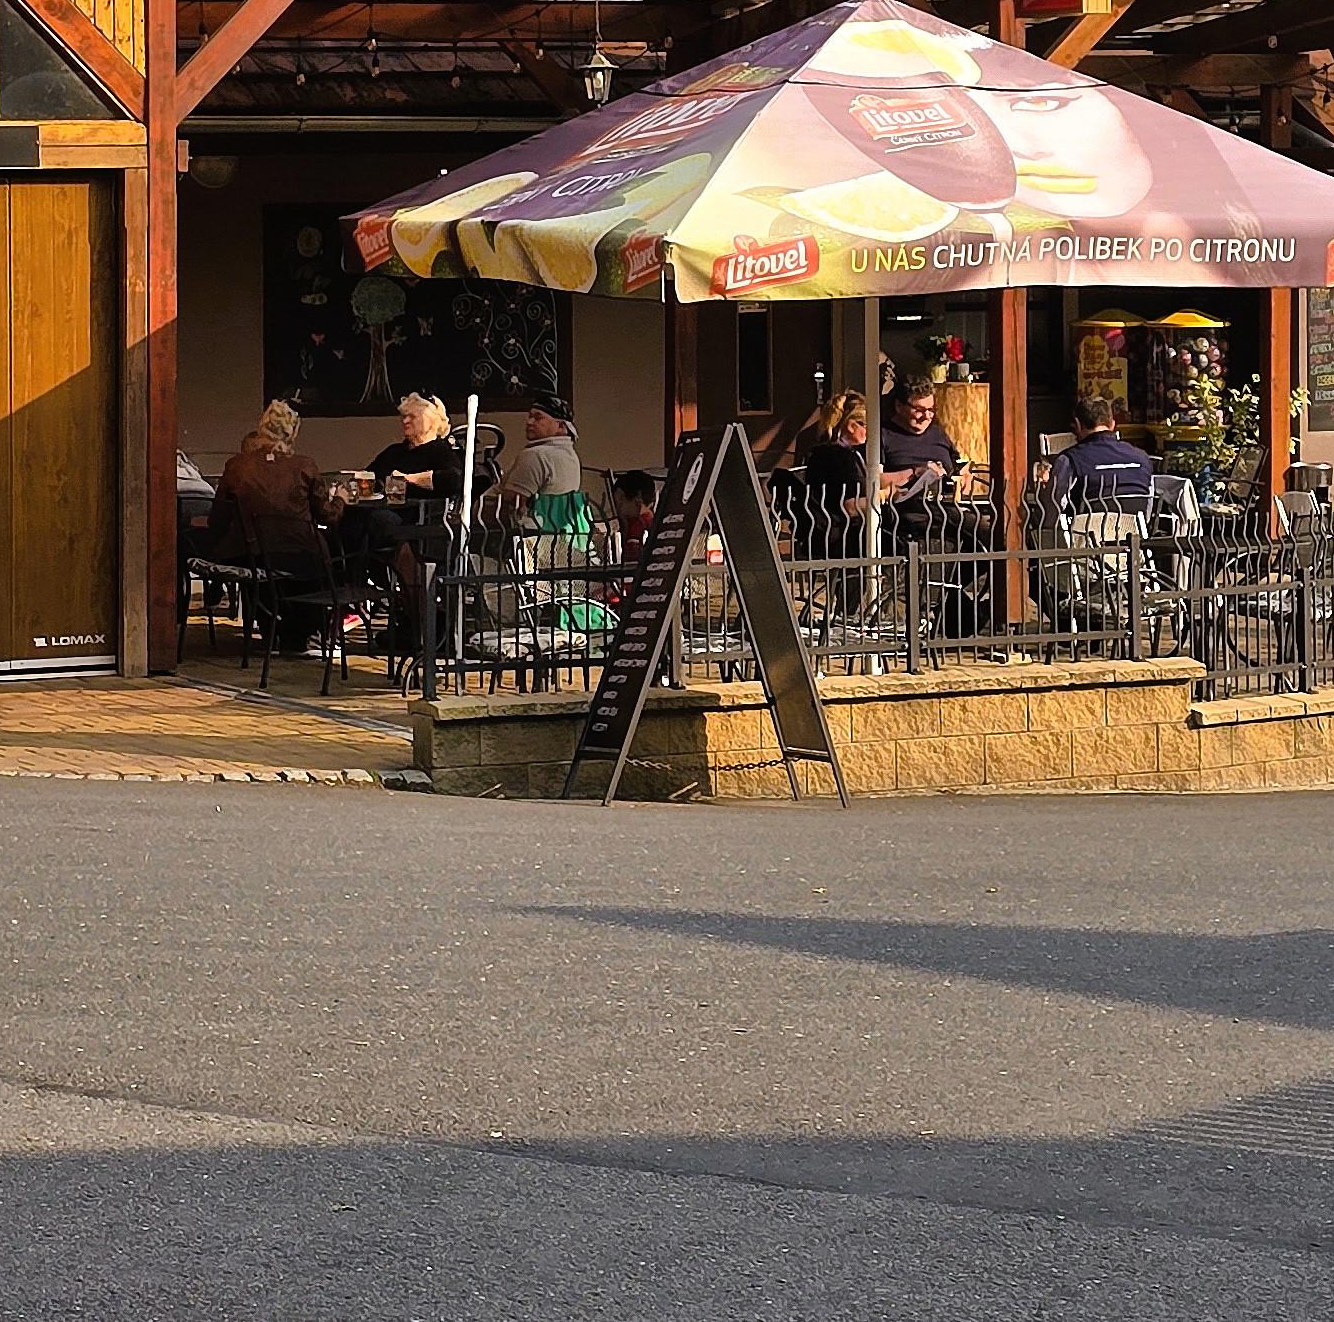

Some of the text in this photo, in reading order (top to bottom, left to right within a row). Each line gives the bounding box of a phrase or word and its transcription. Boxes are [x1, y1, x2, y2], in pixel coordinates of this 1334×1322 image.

[861, 103, 953, 131] Litovel
[725, 241, 809, 290] Litovel
[851, 236, 1297, 273] U NÁS CHUTNÁ POLIBEK PO CITRONU
[51, 634, 106, 646] LOMAX
